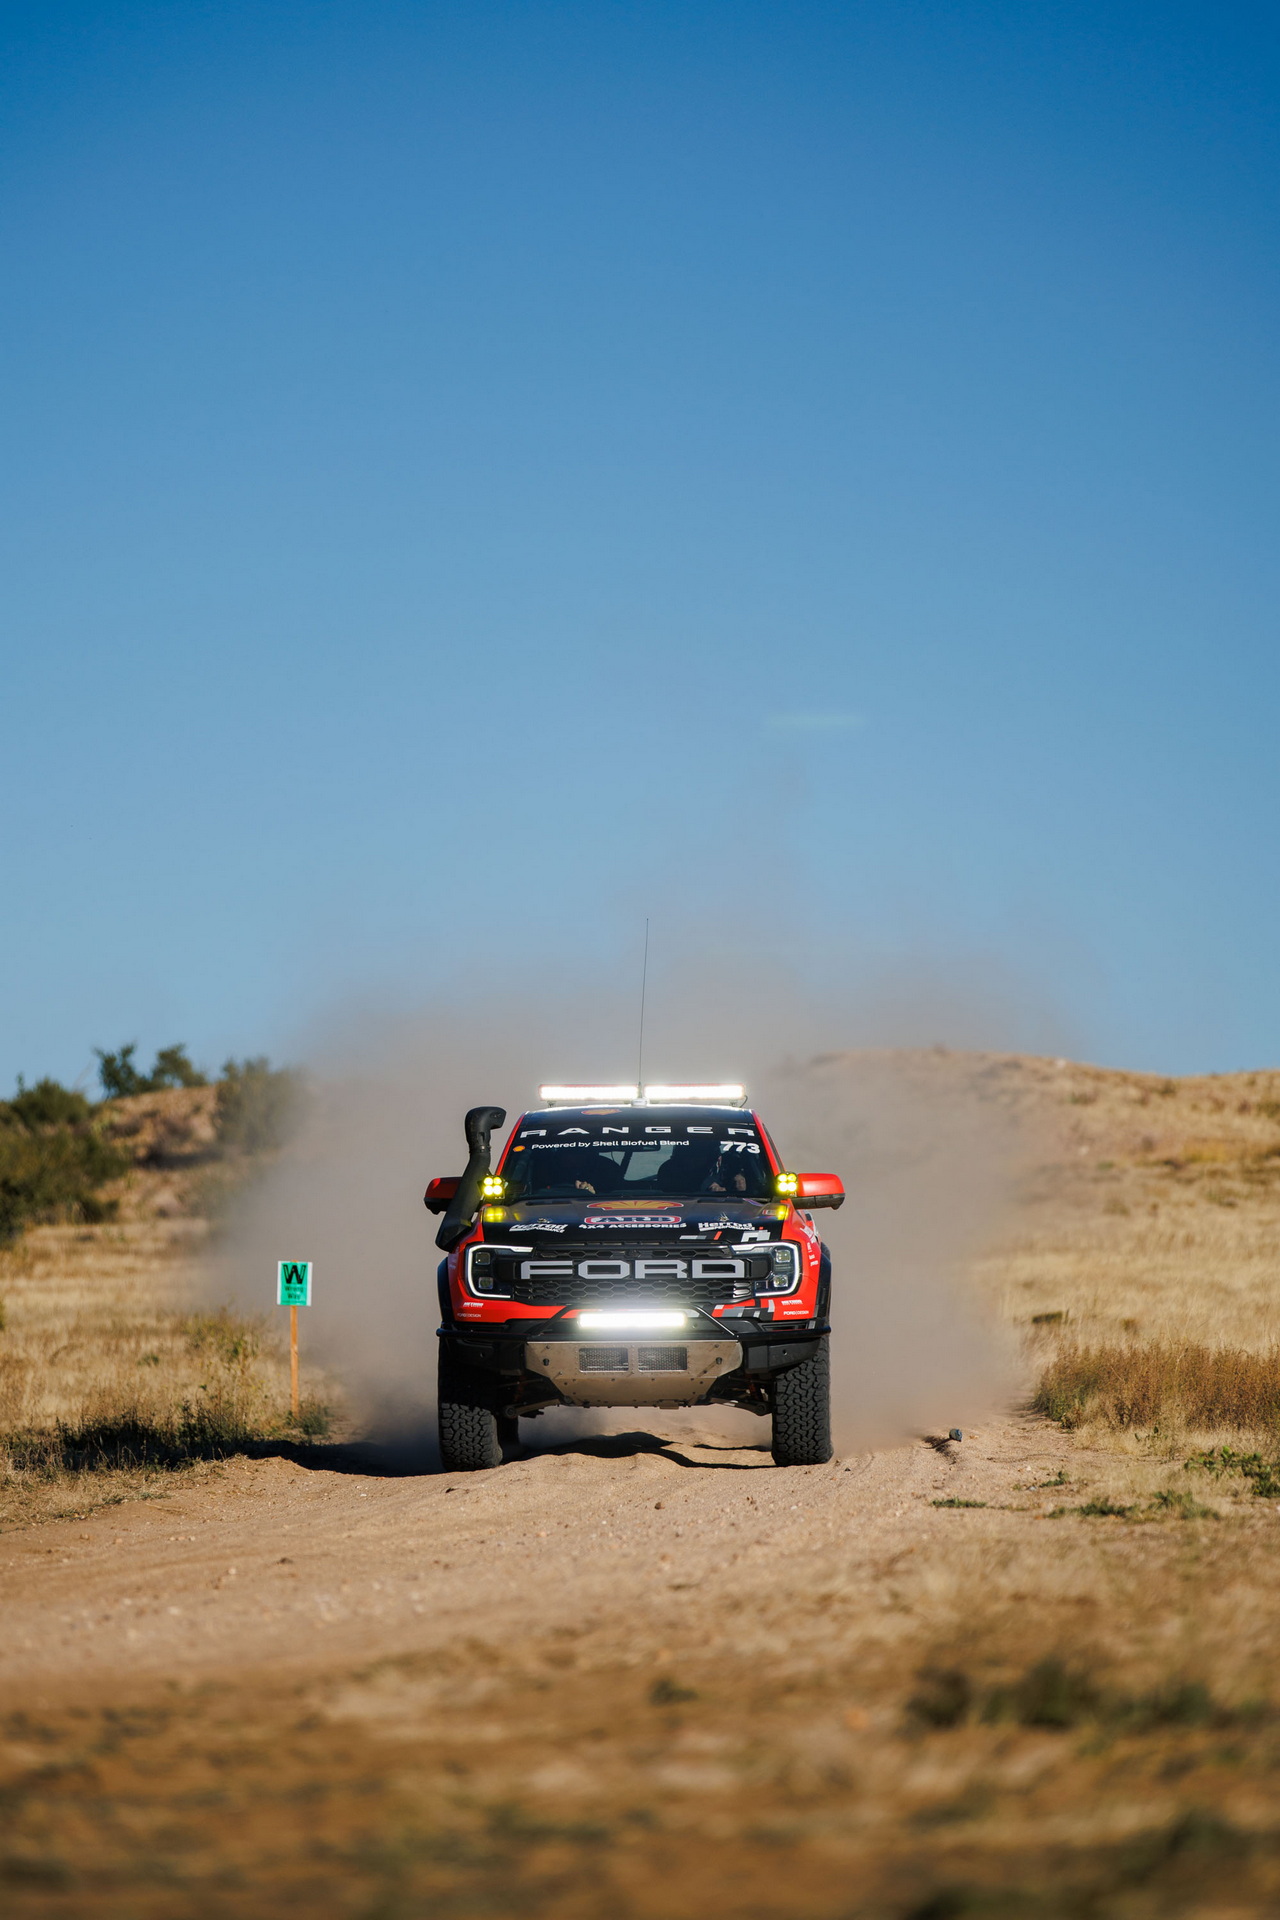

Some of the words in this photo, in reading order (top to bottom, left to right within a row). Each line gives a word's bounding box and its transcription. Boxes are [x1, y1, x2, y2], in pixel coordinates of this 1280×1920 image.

[520, 1126, 755, 1138] RANGER
[531, 1142, 576, 1150] Powered
[720, 1141, 760, 1154] 773
[283, 1264, 306, 1284] W
[521, 1259, 745, 1279] FORD
